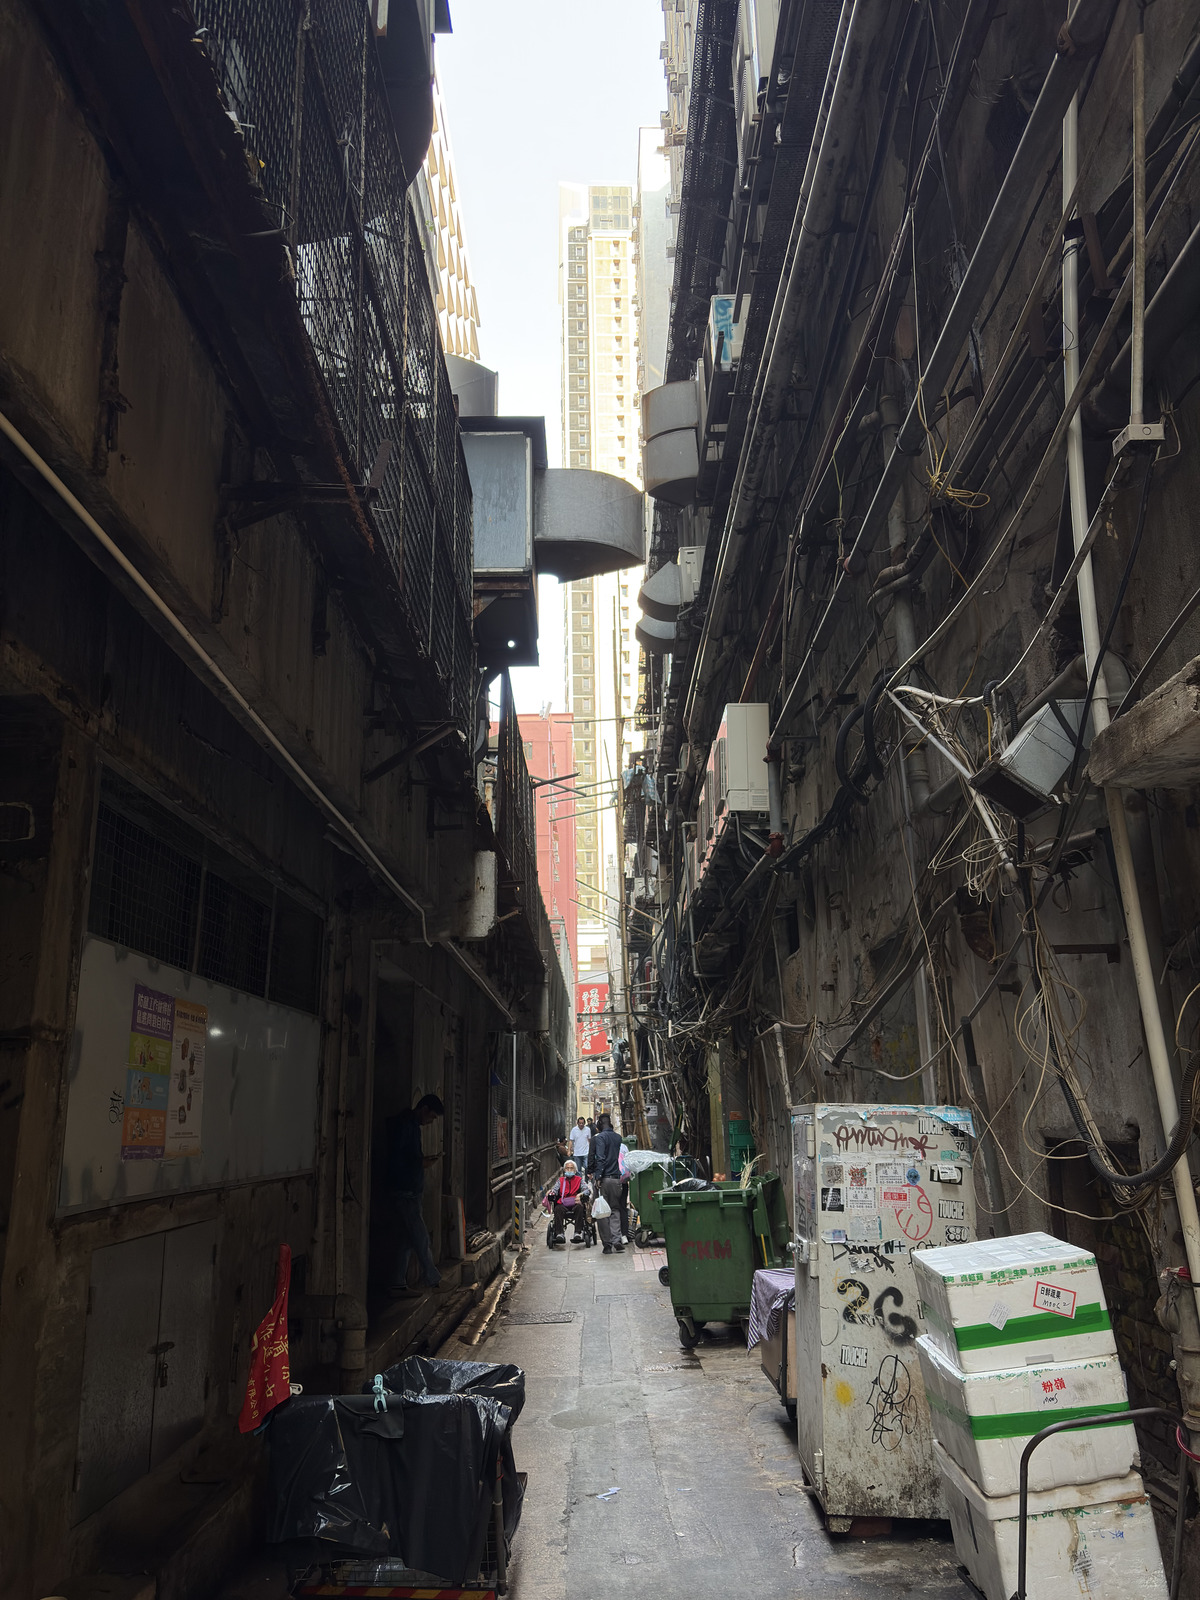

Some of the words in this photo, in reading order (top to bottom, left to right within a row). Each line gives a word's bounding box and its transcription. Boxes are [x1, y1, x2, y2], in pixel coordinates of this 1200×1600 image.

[939, 1200, 964, 1219] TOUCHE
[681, 1239, 732, 1261] CKM
[841, 1345, 868, 1367] TOUCHE
[1041, 1377, 1067, 1394] 粉嶺
